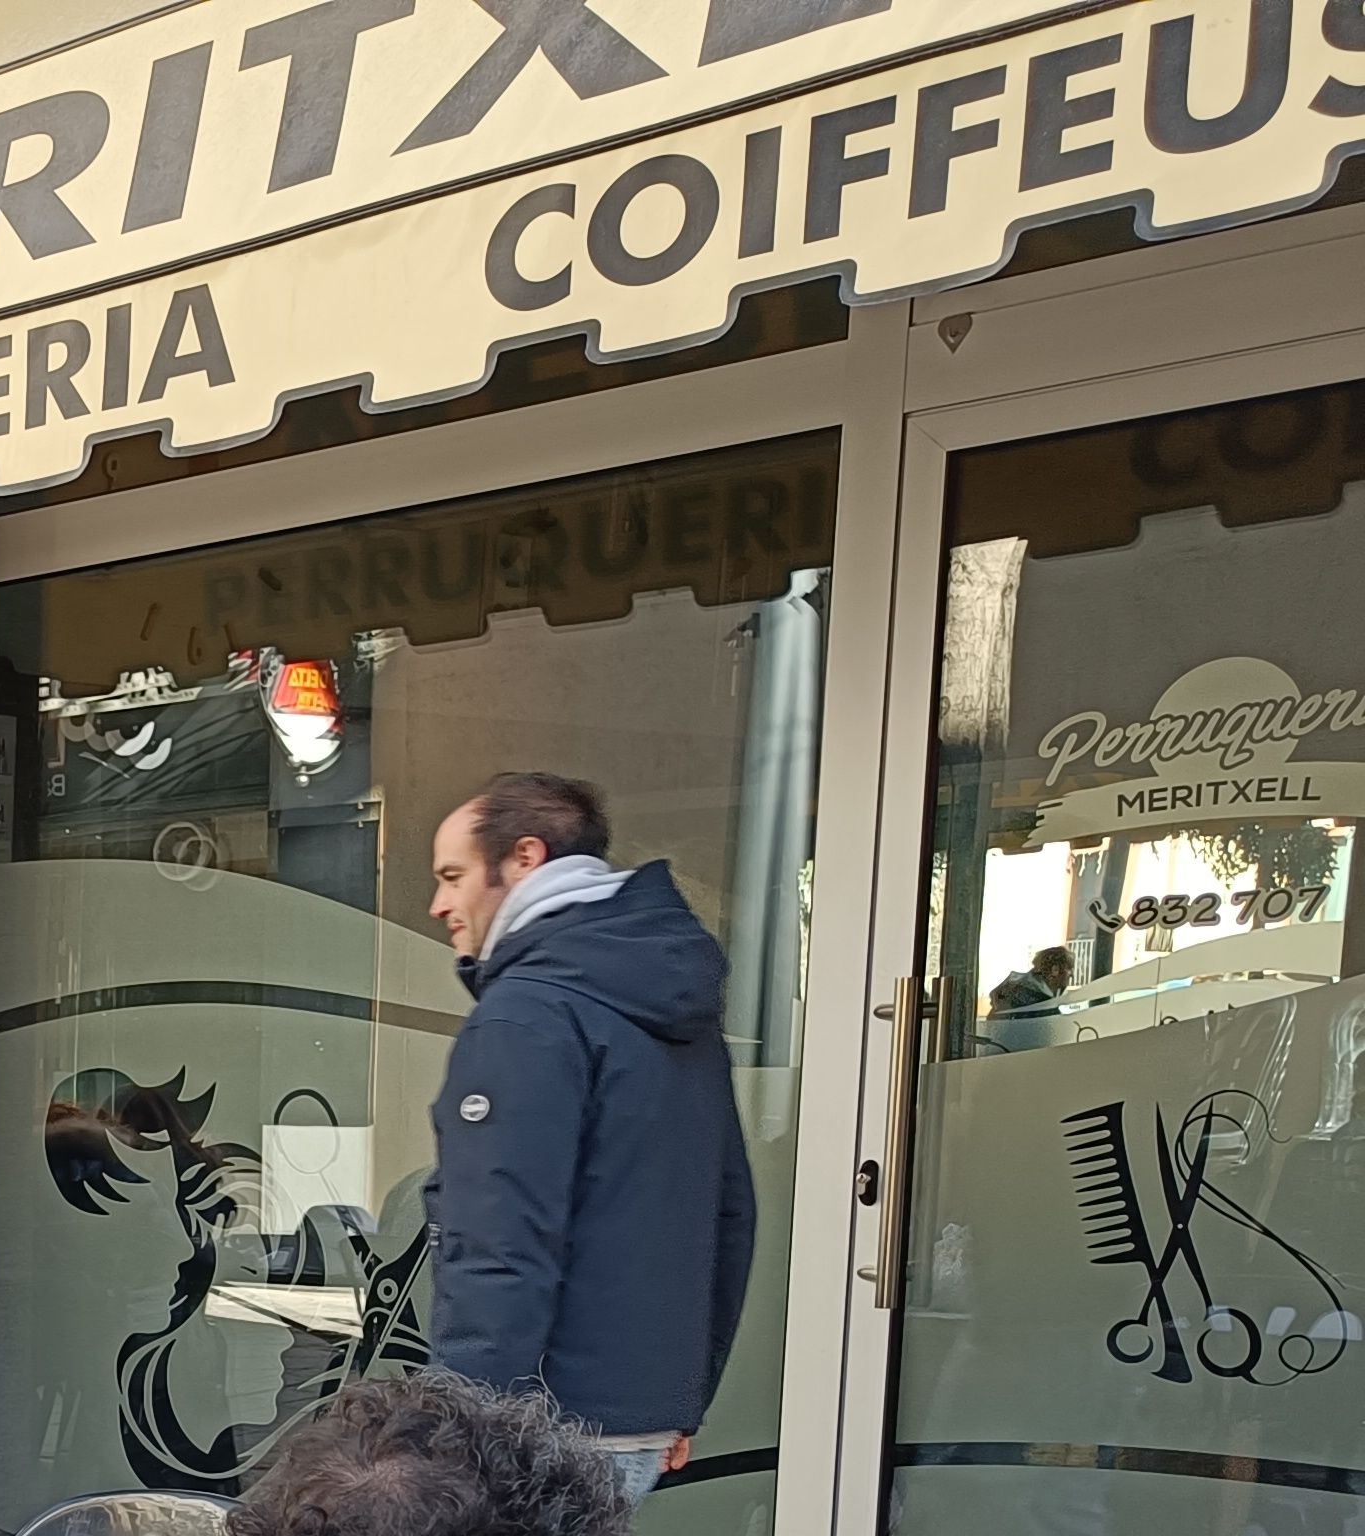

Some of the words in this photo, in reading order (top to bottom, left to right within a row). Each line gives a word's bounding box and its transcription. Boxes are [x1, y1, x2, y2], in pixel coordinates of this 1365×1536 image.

[1117, 777, 1322, 818] MERITXELL
[1129, 896, 1221, 929] 832
[1231, 886, 1329, 923] 707
